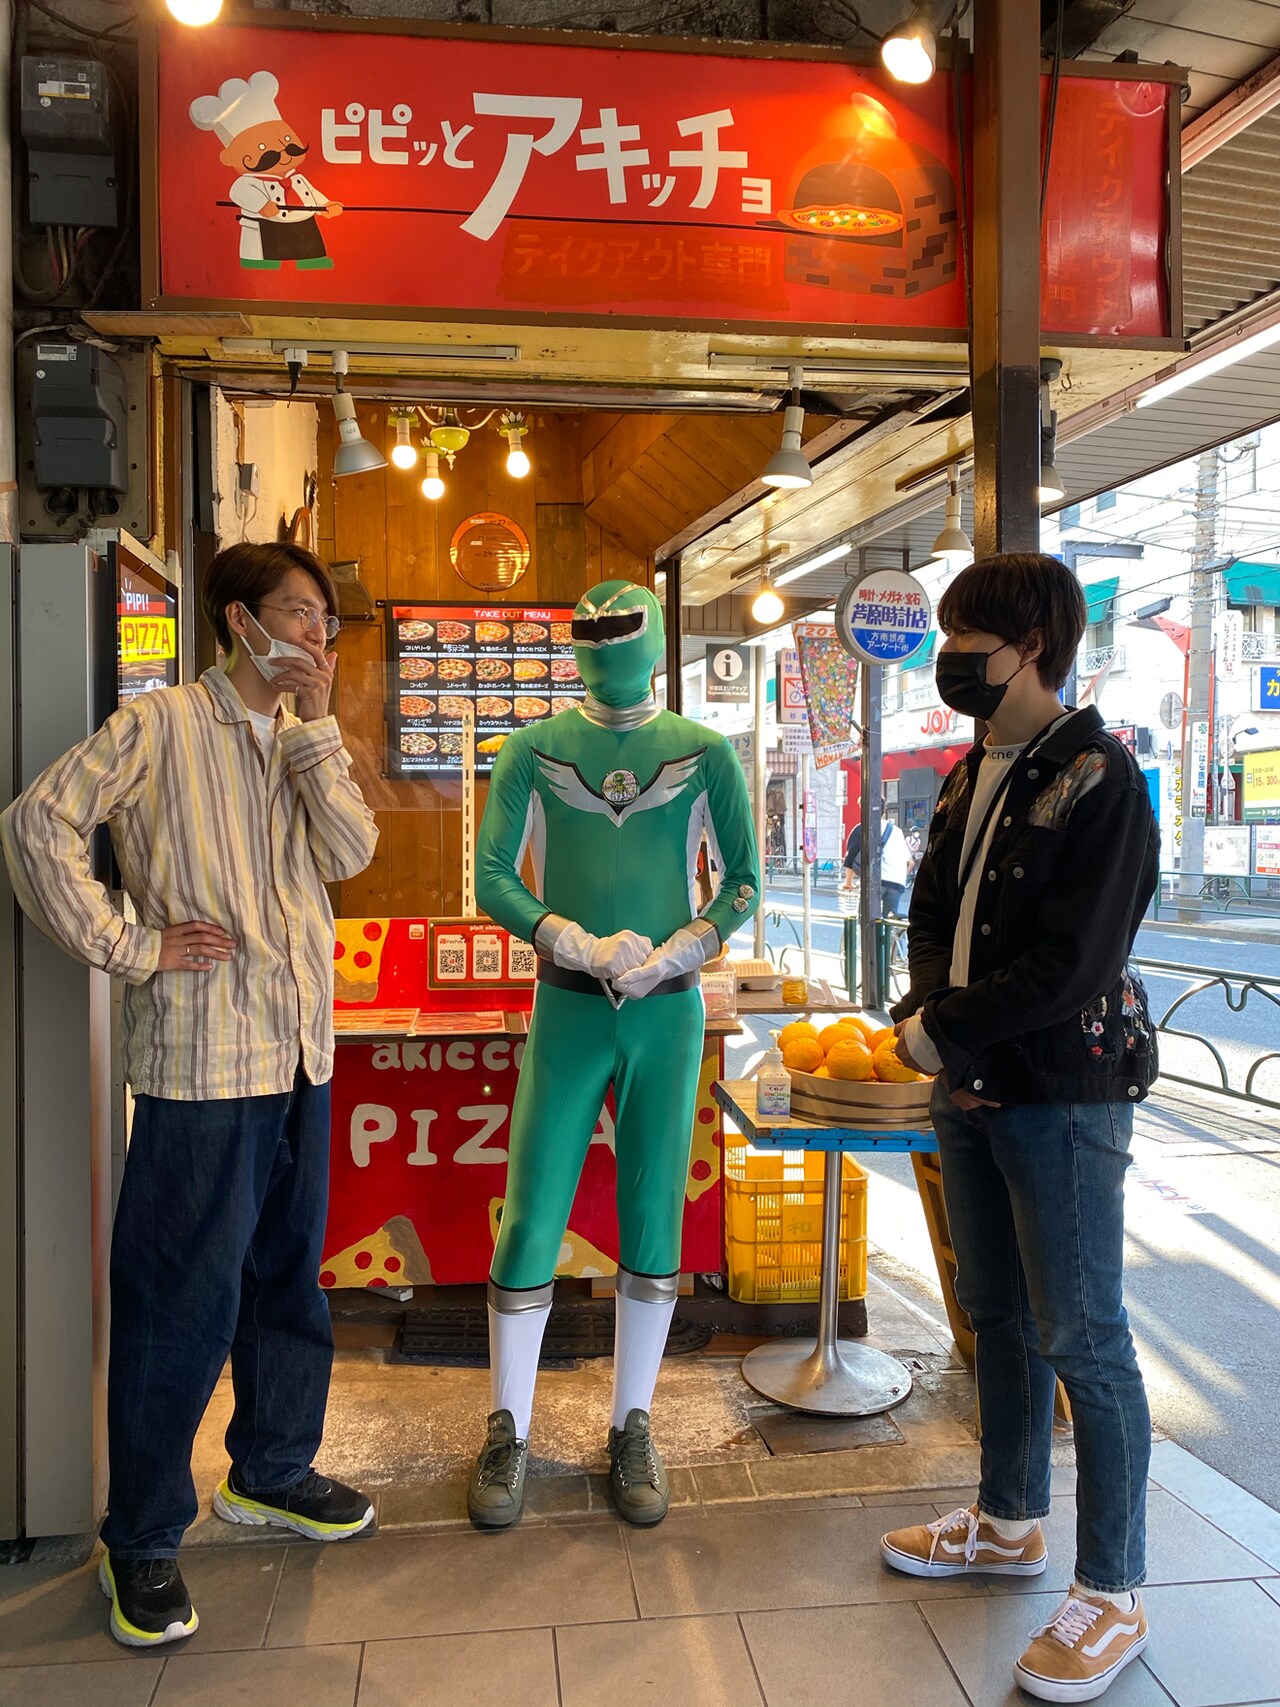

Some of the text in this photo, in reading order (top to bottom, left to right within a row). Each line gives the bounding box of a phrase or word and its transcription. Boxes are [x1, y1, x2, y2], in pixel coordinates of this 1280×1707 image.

[513, 233, 772, 286] テイクアウト専門
[126, 593, 149, 611] PIPI!
[858, 588, 922, 605] 時計・メガネ・宝石
[474, 610, 551, 619] TAKE OUT MENU
[850, 603, 928, 629] 芦原時計店
[123, 622, 172, 658] PIZZA
[867, 640, 909, 652] アーケード街
[871, 632, 906, 643] 方南銀座
[920, 709, 954, 734] JOY
[1197, 754, 1206, 789] はら医院
[350, 1103, 617, 1168] PIZA
